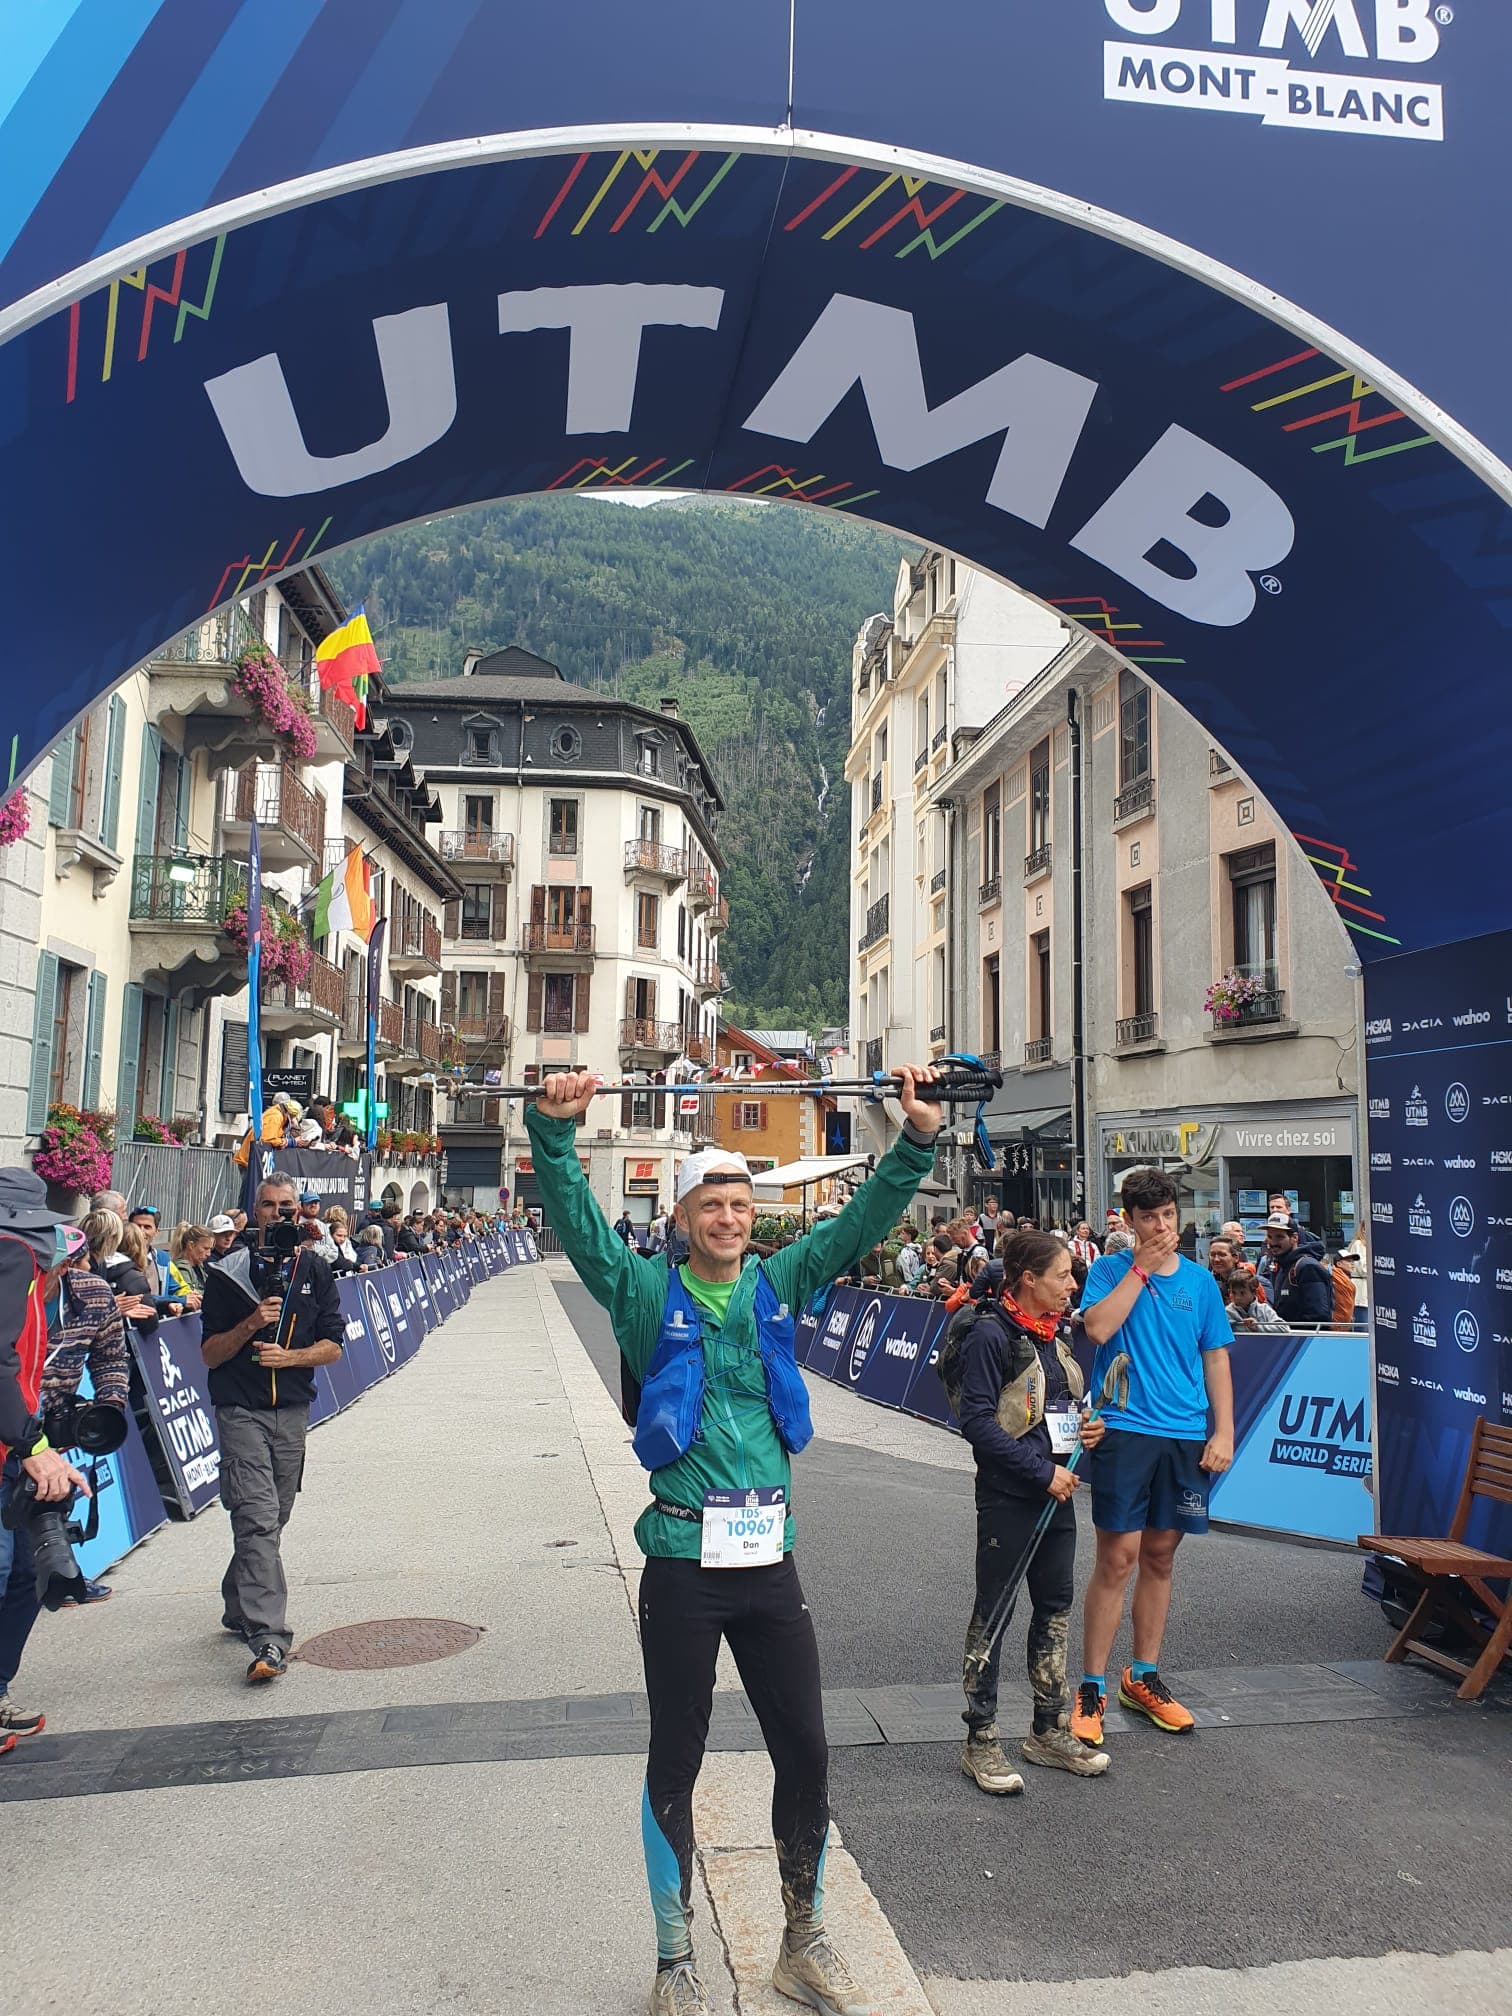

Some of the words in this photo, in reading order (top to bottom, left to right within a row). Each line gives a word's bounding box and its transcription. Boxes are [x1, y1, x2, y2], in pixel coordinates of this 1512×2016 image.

[1402, 1017, 1443, 1032] DACIA
[1452, 1008, 1491, 1027] wahoo
[1366, 1018, 1392, 1036] HOKA
[1369, 1098, 1390, 1110] UTMB
[1482, 1095, 1512, 1105] DACI
[1405, 1106, 1428, 1117] UTMB
[1236, 1130, 1273, 1147] Vivre
[1276, 1129, 1310, 1147] chez
[1313, 1128, 1336, 1146] soi
[1371, 1153, 1392, 1165] HOKA
[1402, 1158, 1434, 1166] DACIA
[1443, 1154, 1476, 1169] wahoo
[1491, 1150, 1512, 1164] HOK
[1372, 1203, 1393, 1215] UTMB
[1409, 1215, 1432, 1228] UTMB
[1488, 1217, 1512, 1226] DAC
[1374, 1255, 1396, 1269] HOKA
[1406, 1265, 1439, 1276] DACIA
[1448, 1268, 1481, 1284] wahoo
[1495, 1268, 1512, 1283] HO
[1375, 1305, 1397, 1320] UTMB
[827, 1310, 850, 1337] HOKA
[1413, 1322, 1437, 1338] UTMB
[885, 1331, 918, 1361] wahoo
[1378, 1362, 1399, 1379] HOKA
[1410, 1376, 1444, 1392] DACIA
[158, 1385, 200, 1416] DACIA
[1453, 1386, 1487, 1405] wahoo
[1278, 1394, 1372, 1442] UTM
[1276, 1443, 1329, 1464] WORLD
[1332, 1454, 1372, 1474] SERIE
[741, 1508, 760, 1519] TDS
[726, 1517, 775, 1537] 10967
[743, 1540, 760, 1549] Dan
